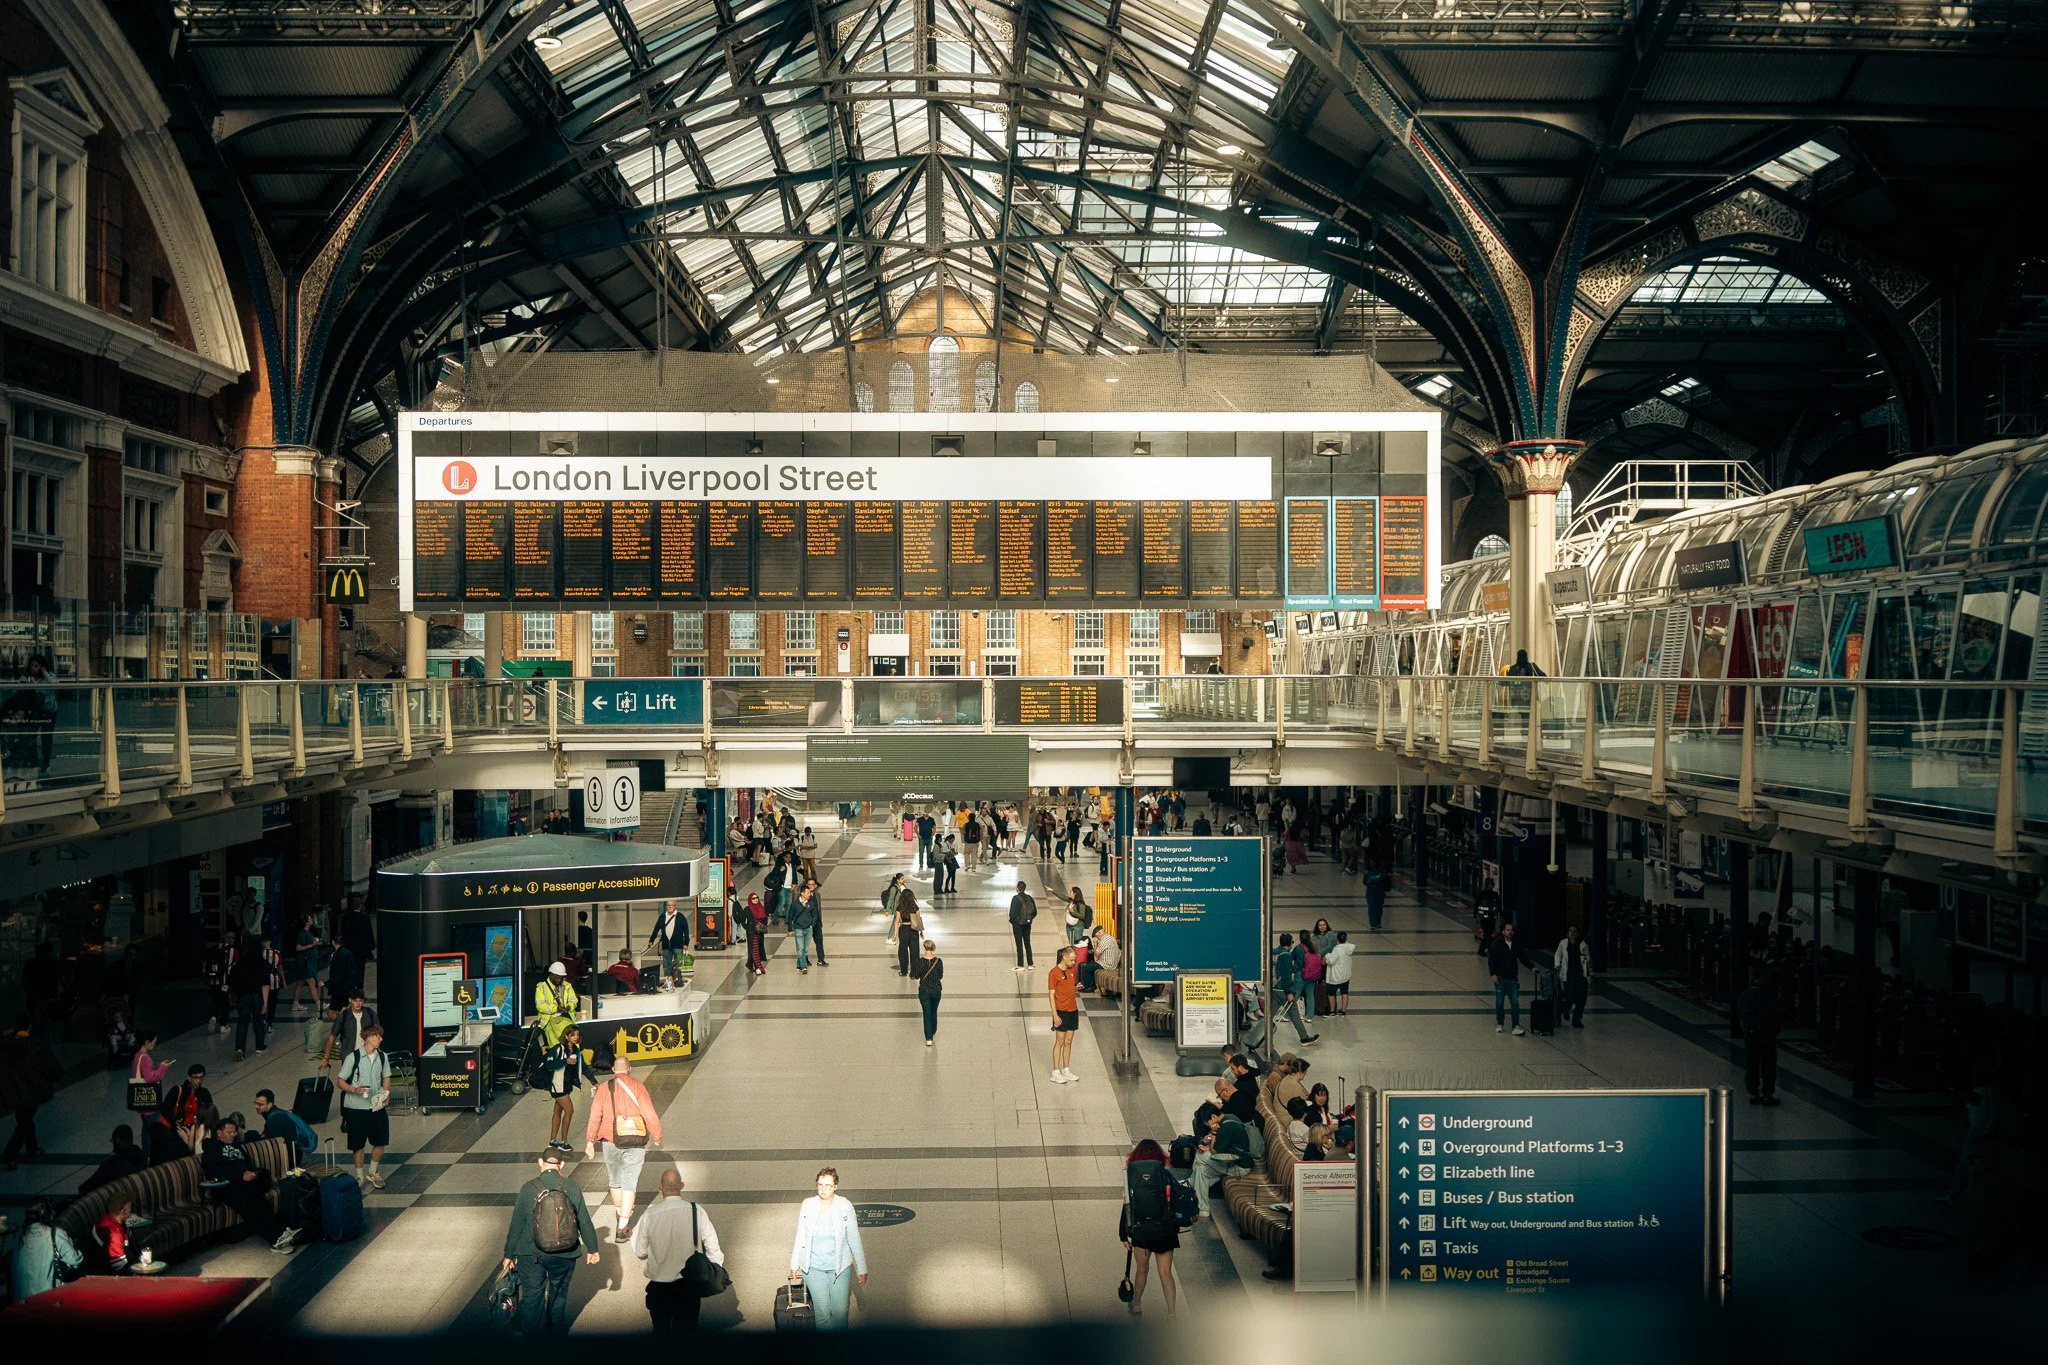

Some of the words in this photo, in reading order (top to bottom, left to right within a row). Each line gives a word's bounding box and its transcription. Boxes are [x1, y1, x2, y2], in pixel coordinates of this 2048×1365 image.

[419, 417, 473, 428] Departures
[494, 465, 614, 491] London
[623, 465, 770, 498] Liverpool
[779, 465, 878, 491] Street
[1827, 531, 1867, 563] LEON
[1680, 561, 1705, 575] NATURALLY
[1705, 560, 1716, 571] FAST
[1716, 558, 1731, 571] FOOD
[645, 694, 677, 710] Lift
[609, 814, 639, 825] Information
[1482, 817, 1492, 831] 8
[1519, 827, 1529, 842] 9
[1155, 846, 1192, 854] Underground
[542, 879, 596, 893] Passenger
[597, 876, 660, 890] Accessibility
[431, 1073, 470, 1083] Passenger
[430, 1081, 470, 1090] Assistance
[440, 1089, 460, 1097] Point
[1443, 1115, 1533, 1132] Underground
[1443, 1140, 1525, 1157] Overground
[1529, 1140, 1595, 1153] Platforms
[1443, 1165, 1507, 1179] Elizabeth
[1511, 1165, 1535, 1179] line
[1443, 1190, 1484, 1205] Buses
[1498, 1190, 1524, 1204] Bus
[1526, 1190, 1574, 1204] station
[1443, 1215, 1468, 1229] Lift
[1470, 1219, 1488, 1231] Way
[1510, 1219, 1567, 1231] Underground
[1569, 1219, 1585, 1229] and
[1586, 1219, 1602, 1229] Bus
[1604, 1219, 1634, 1229] station
[1443, 1241, 1479, 1254] Taxis
[1443, 1266, 1473, 1282] Way
[1475, 1267, 1499, 1280] out
[1515, 1269, 1550, 1277] Broadgate
[1515, 1277, 1548, 1285] Exchange
[1548, 1277, 1571, 1285] Square
[1505, 1286, 1537, 1295] Liverpool
